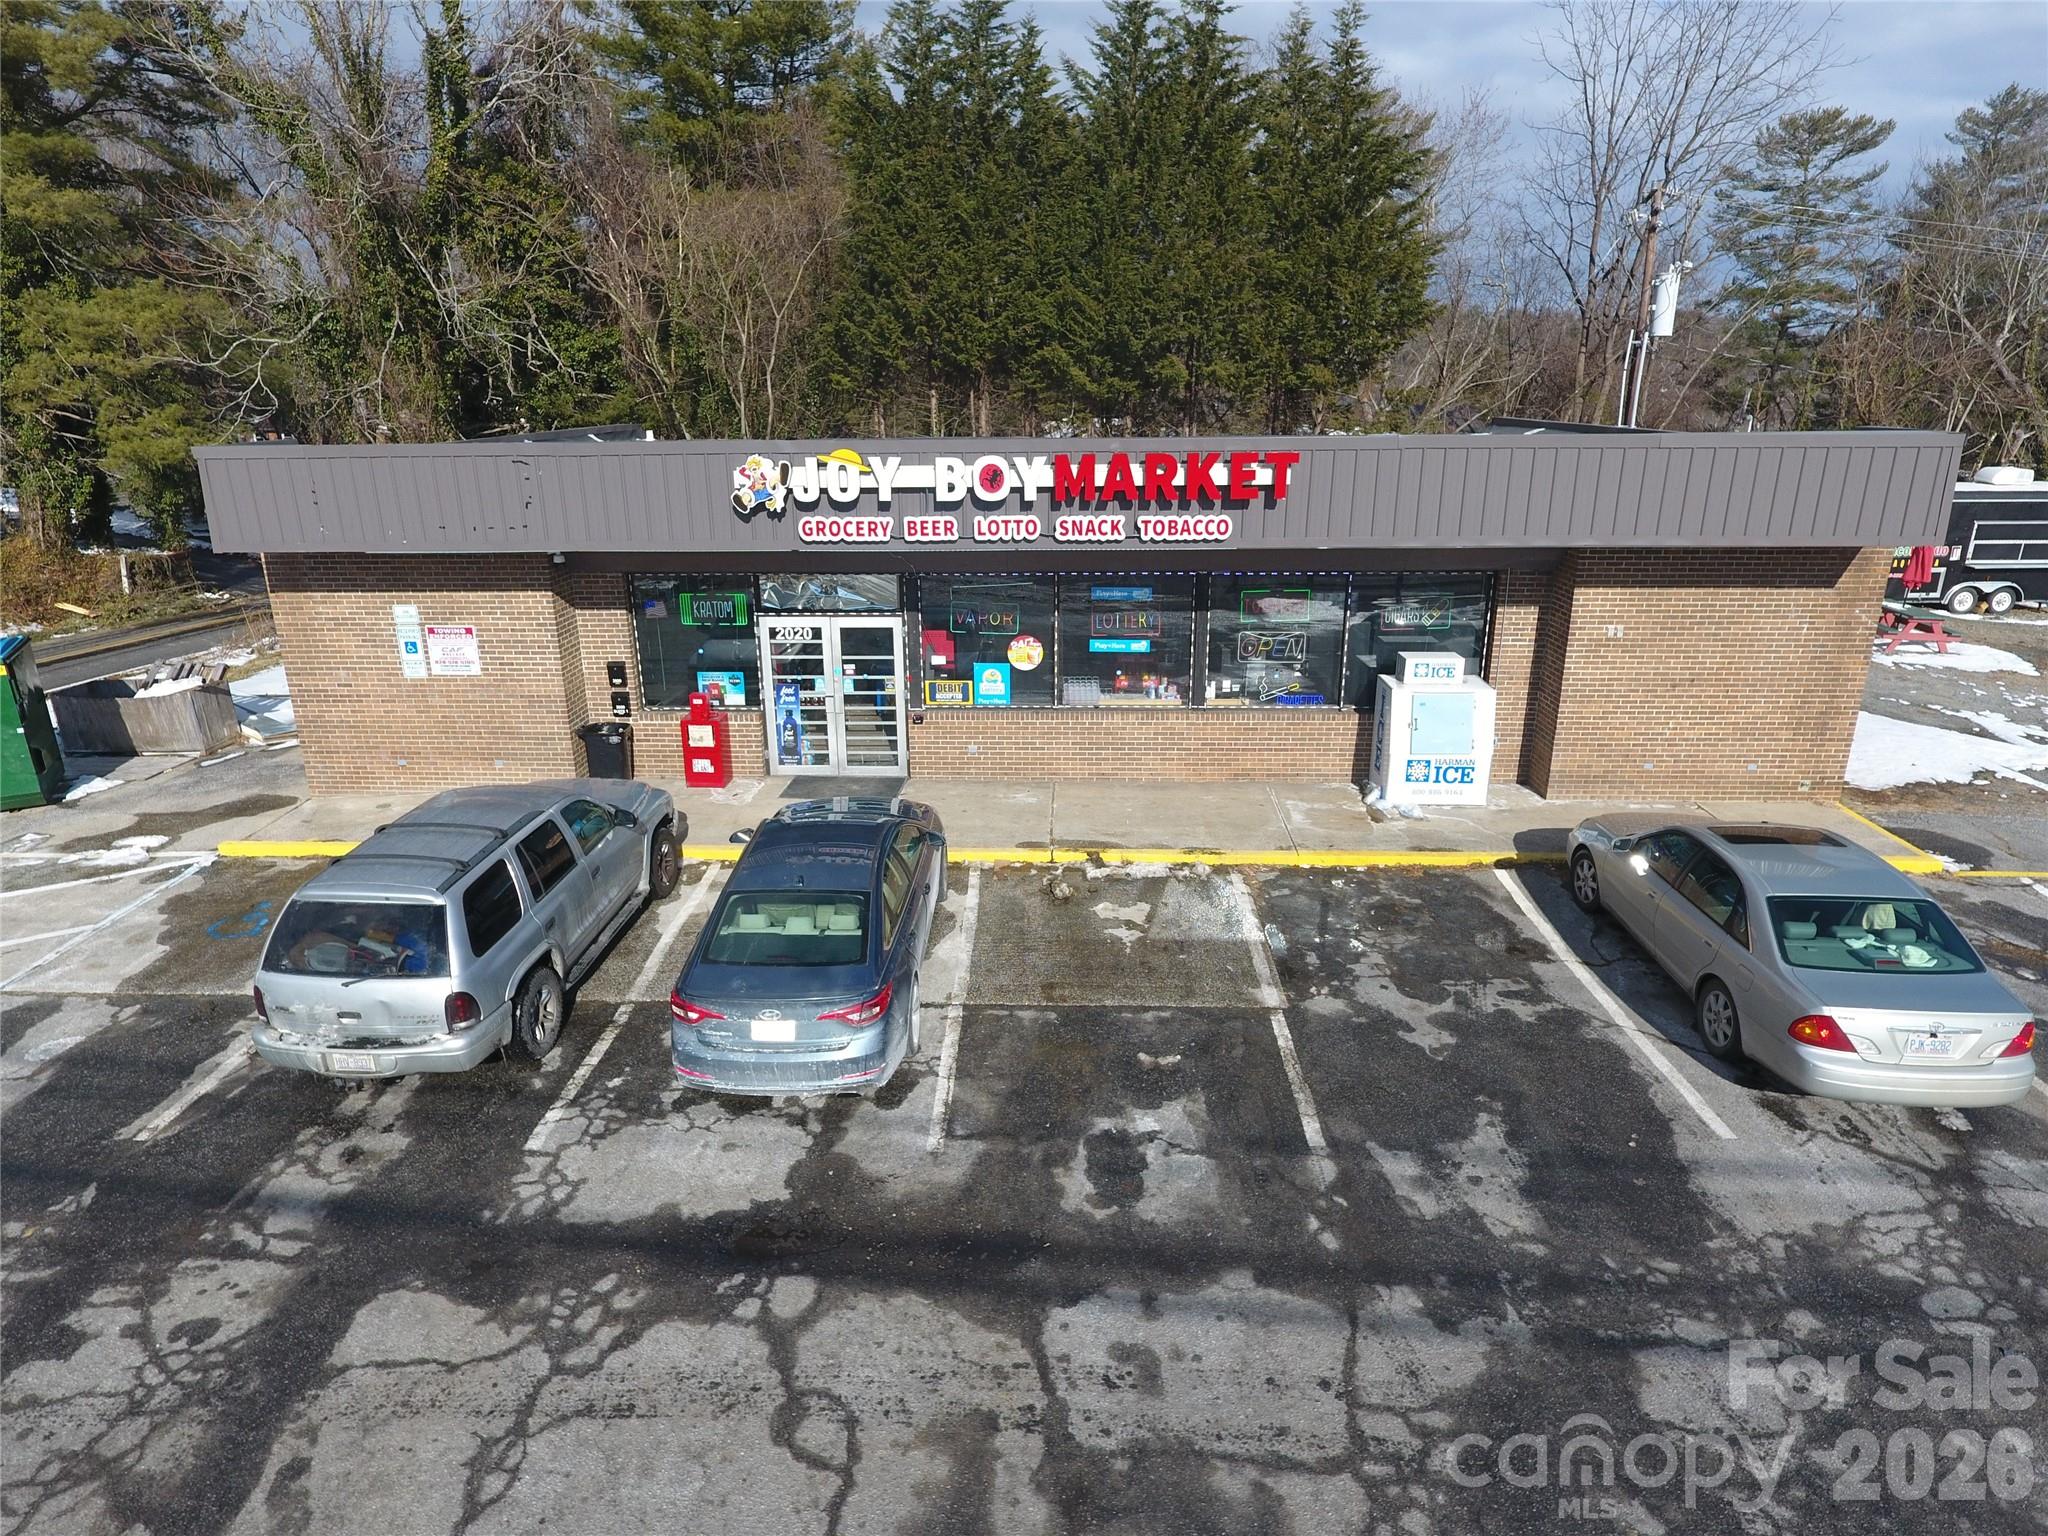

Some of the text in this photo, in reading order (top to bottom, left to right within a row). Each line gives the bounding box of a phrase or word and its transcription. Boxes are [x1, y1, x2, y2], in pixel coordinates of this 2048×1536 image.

[793, 451, 1300, 503] JOY BOY MARKET
[801, 518, 1230, 539] GROCERY BEER LOTTO SNACK TOBACCO
[692, 600, 734, 620] KRATOM
[956, 610, 1015, 626] VAPOR
[1384, 606, 1420, 624] CIGARS
[1095, 611, 1154, 629] LOTTERY
[775, 626, 813, 641] 2020
[1240, 637, 1304, 659] OPEN
[1431, 666, 1456, 679] ICE
[937, 683, 962, 693] DEBIT
[1434, 758, 1476, 766] HARMAN
[1432, 766, 1475, 784] ICE
